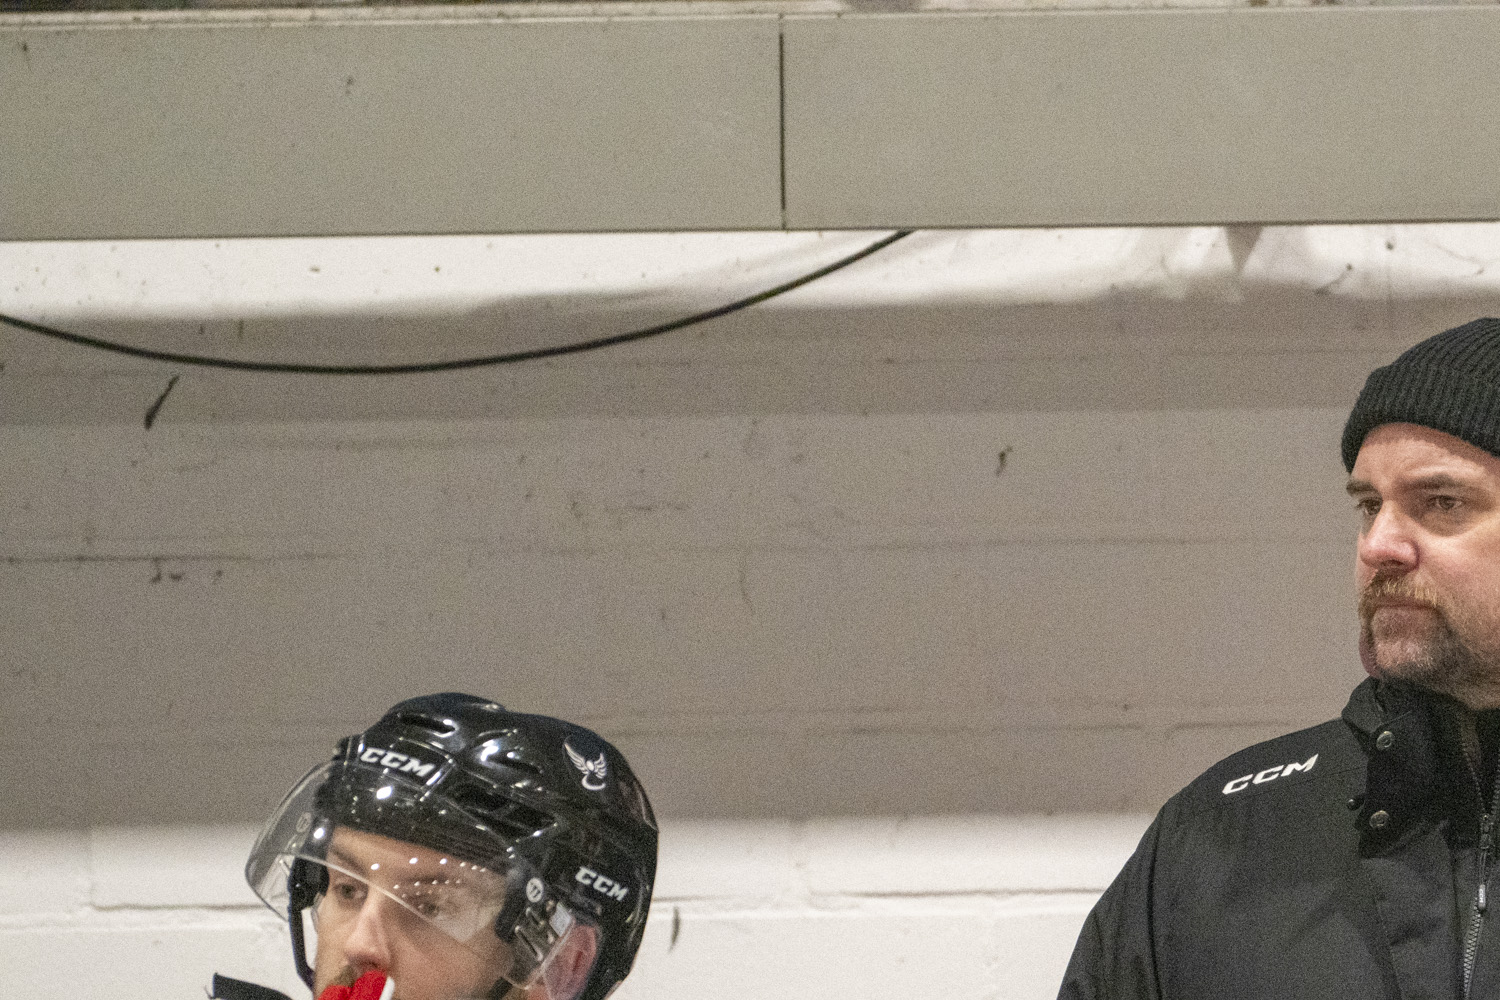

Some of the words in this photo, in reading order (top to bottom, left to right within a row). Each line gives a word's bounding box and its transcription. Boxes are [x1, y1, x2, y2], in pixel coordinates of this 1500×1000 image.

[360, 747, 436, 778] CCM
[1222, 754, 1319, 795] CCM
[575, 866, 629, 901] CCM
